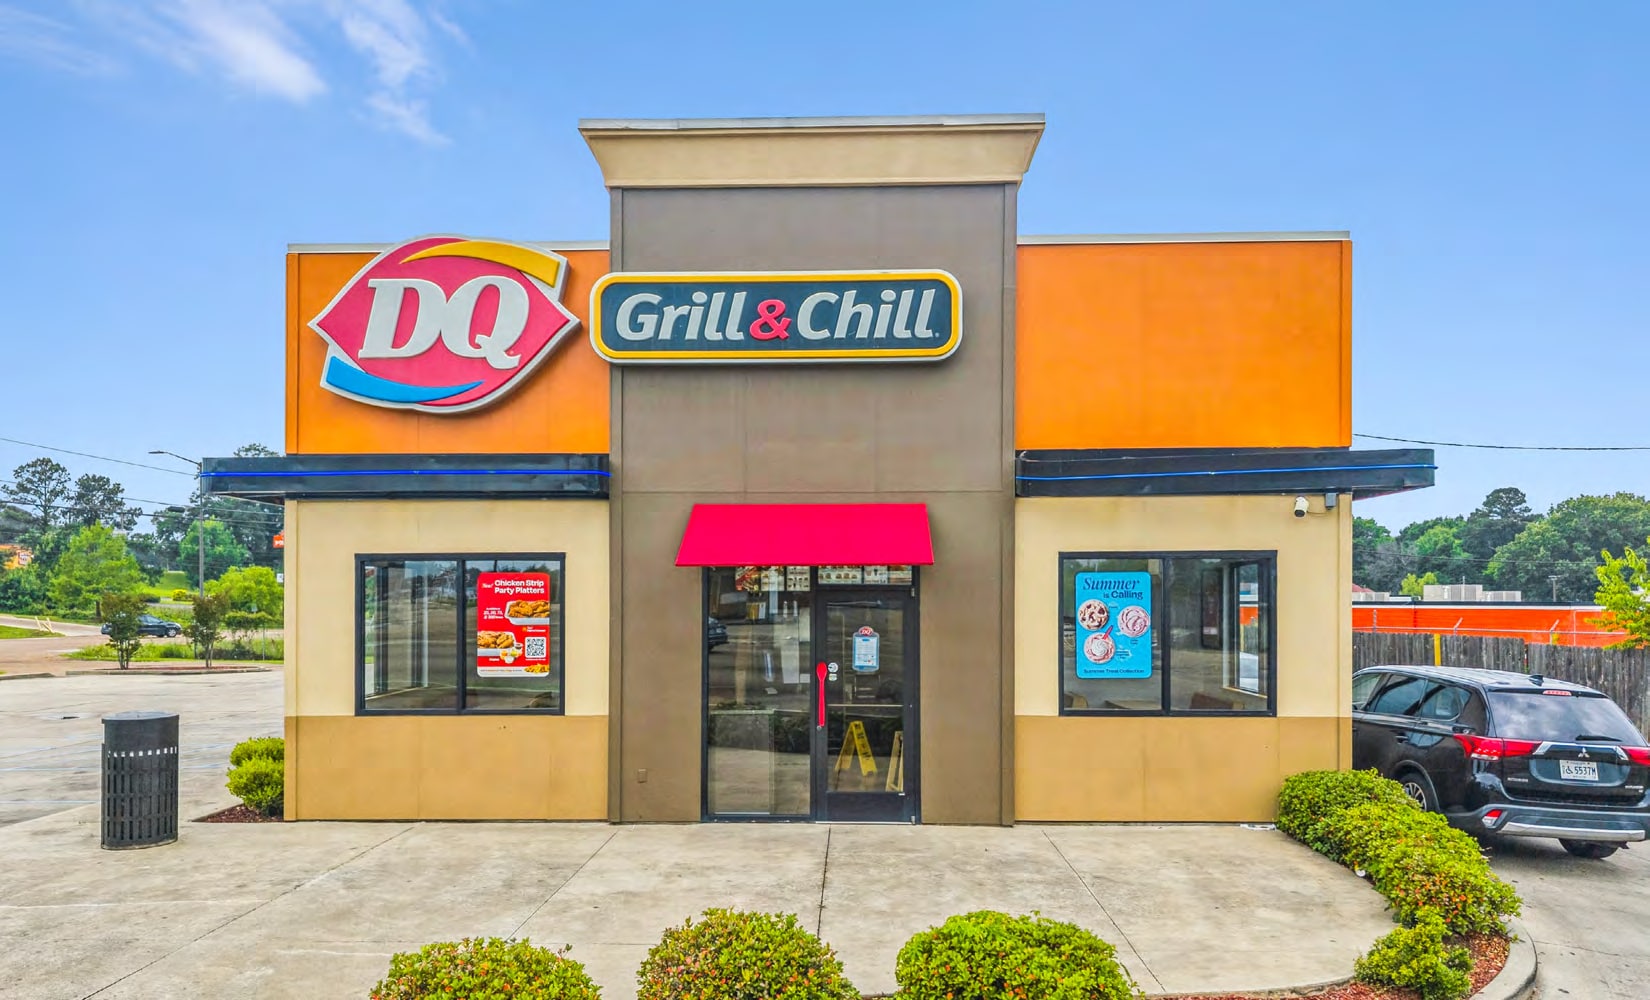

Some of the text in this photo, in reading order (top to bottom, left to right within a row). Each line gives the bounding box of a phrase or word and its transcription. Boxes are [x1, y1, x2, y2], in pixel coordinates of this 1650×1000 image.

[358, 275, 522, 370] DQ
[494, 579, 545, 588] Chicken Strip
[1083, 576, 1140, 590] Summer
[494, 587, 515, 596] Party
[1103, 590, 1144, 600] is Calling
[1574, 766, 1597, 776] 5537M
